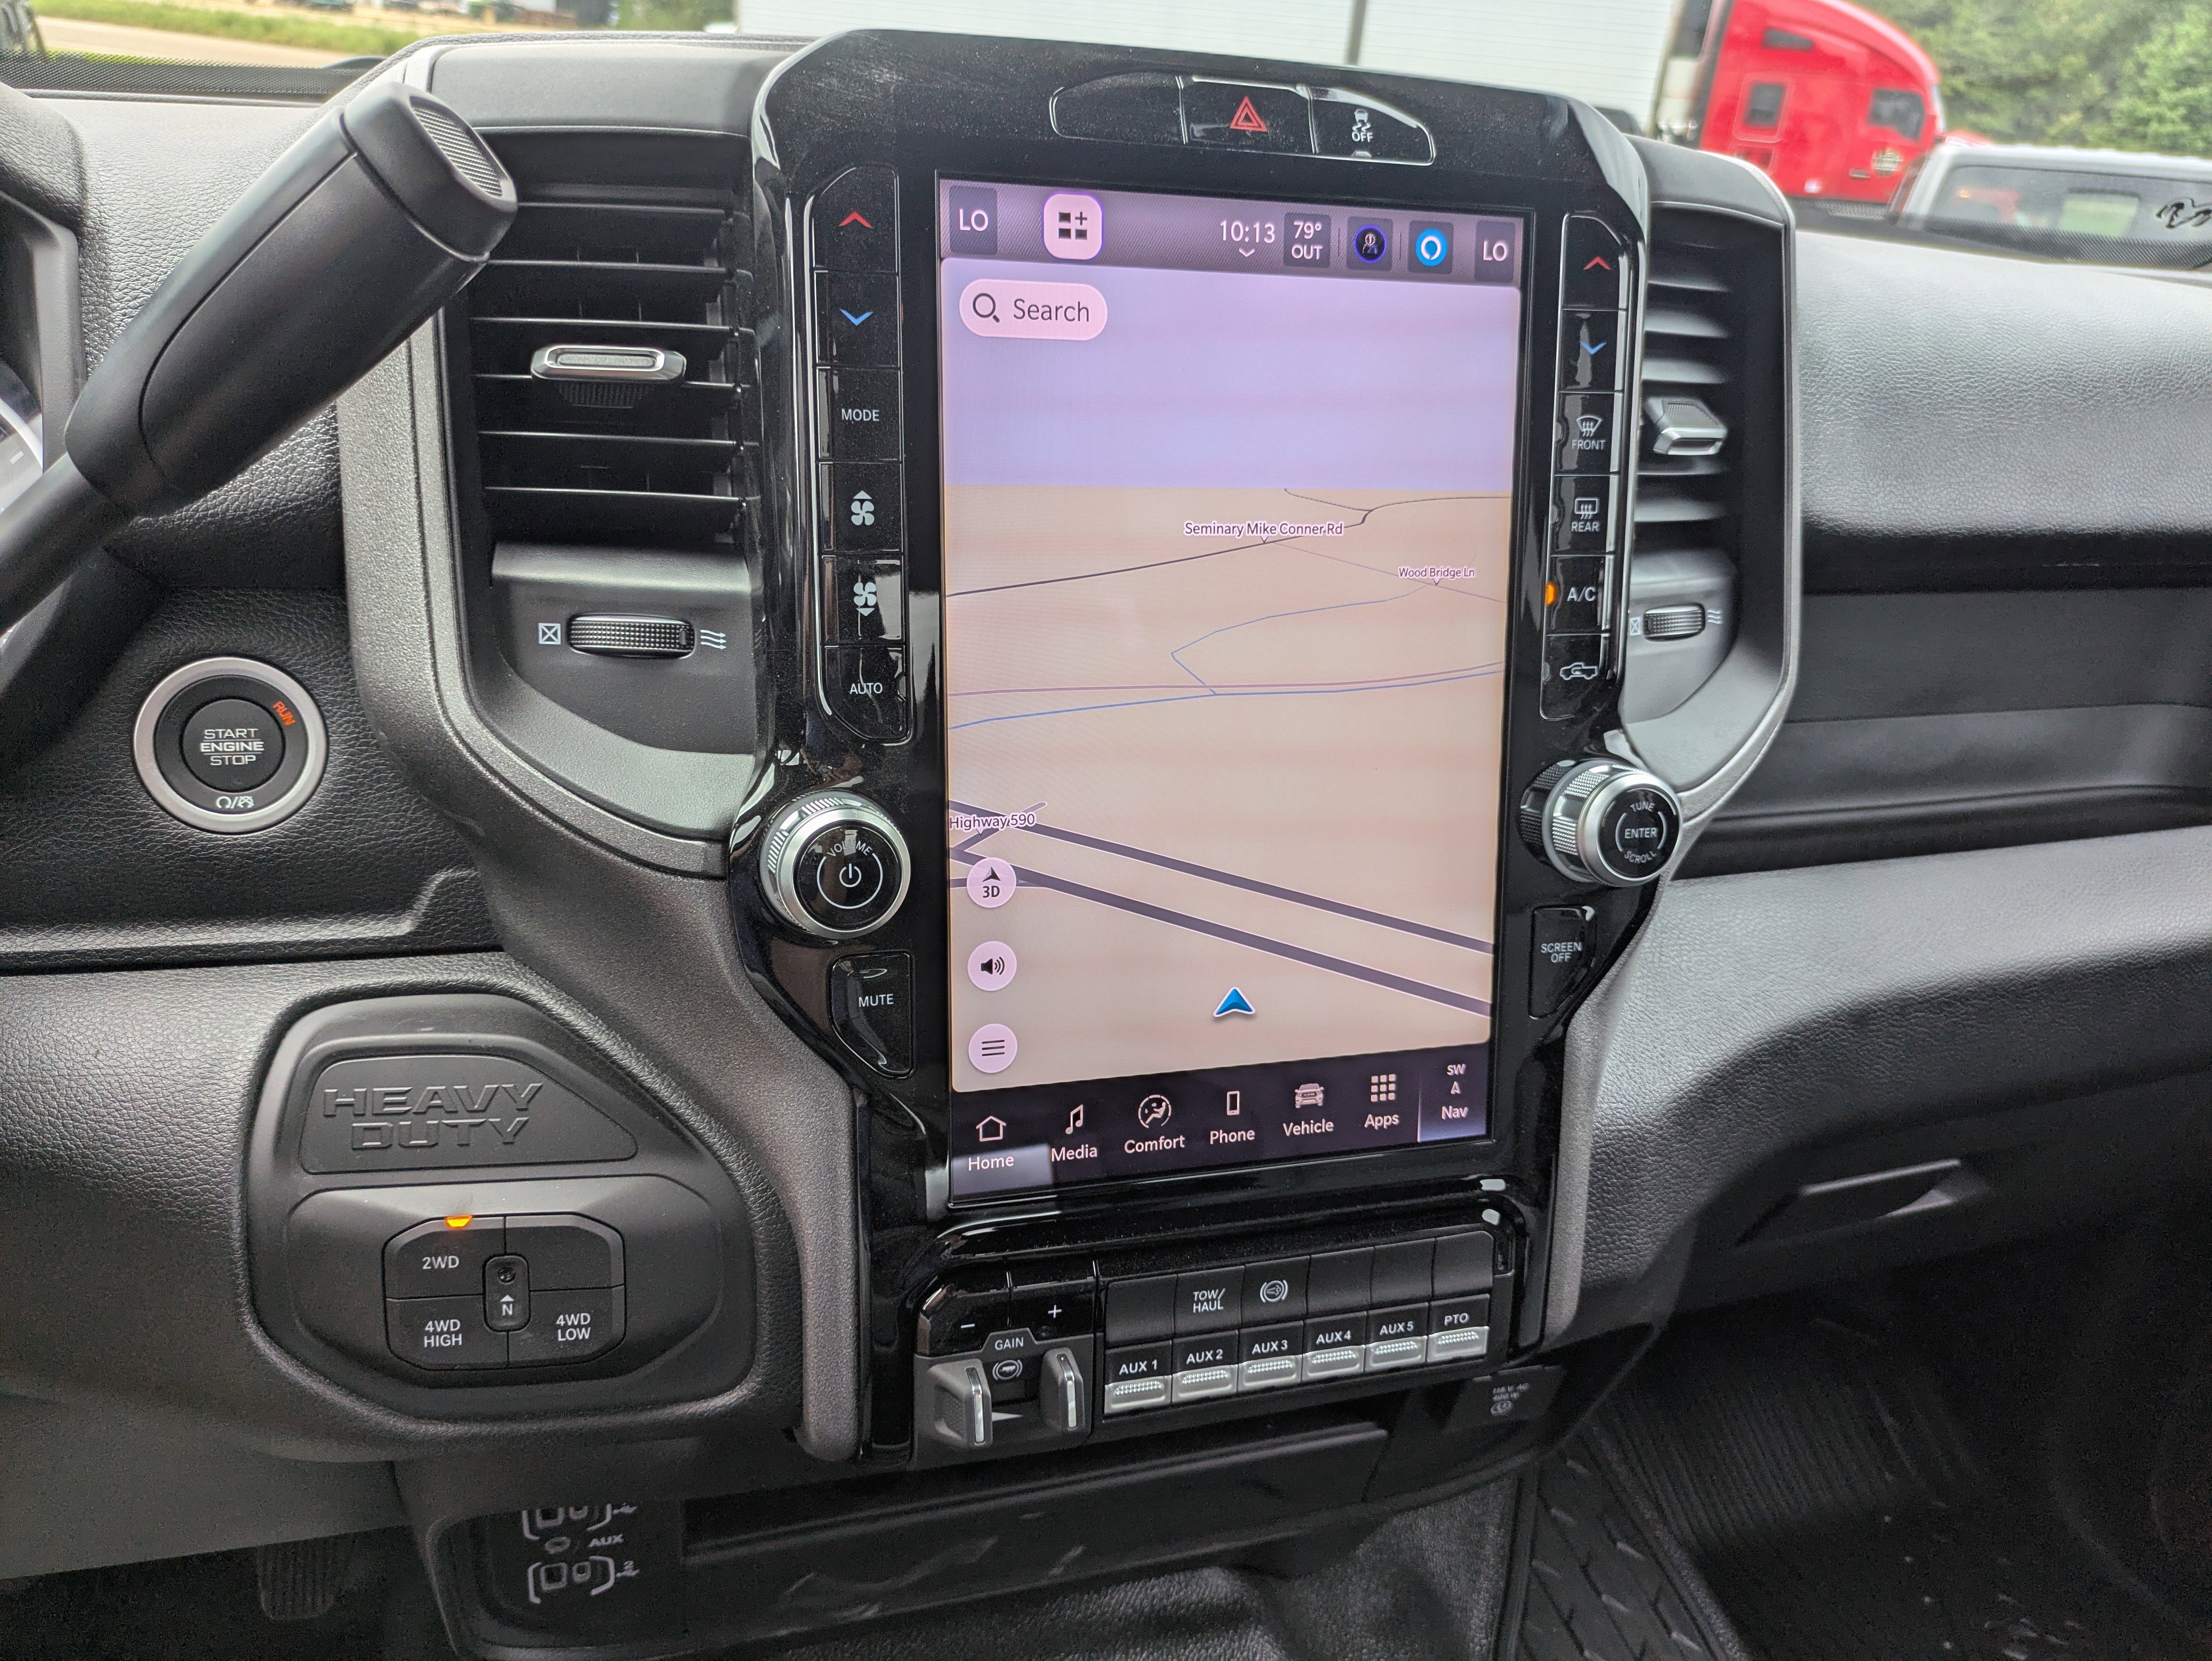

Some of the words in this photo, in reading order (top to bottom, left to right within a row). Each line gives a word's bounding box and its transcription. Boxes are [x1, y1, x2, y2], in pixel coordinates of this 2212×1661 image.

[1351, 131, 1373, 143] OFF
[958, 209, 989, 232] LO
[1220, 220, 1276, 244] 10:13
[1291, 244, 1323, 261] OUT
[1483, 241, 1508, 262] LO
[1013, 298, 1090, 322] Search
[841, 408, 880, 421] MODE
[1571, 440, 1606, 450] FRONT
[1184, 522, 1243, 537] Seminary
[1247, 522, 1277, 535] Mike
[1279, 523, 1325, 535] Conner
[1326, 522, 1343, 534] Rd
[1571, 522, 1600, 532] REAR
[1398, 567, 1427, 578] Wood
[1429, 567, 1461, 580] Bridge
[1463, 567, 1475, 577] Ln
[1567, 587, 1596, 602] A/C
[849, 683, 883, 695] AUTO
[272, 700, 296, 727] RUN
[203, 728, 259, 739] START
[200, 741, 265, 753] ENGINE
[210, 754, 256, 766] STOP
[1630, 801, 1656, 813] TUNE
[950, 815, 1009, 831] Highway
[1010, 813, 1035, 826] 590
[1625, 827, 1659, 840] ENTER
[826, 838, 873, 857] VOLUME
[1624, 850, 1658, 863] SCROLL
[982, 885, 1000, 898] 3D
[1540, 941, 1582, 953] SCREEN
[1550, 952, 1572, 963] OFF
[858, 994, 894, 1008] MUTE
[1447, 1063, 1466, 1075] SW
[323, 1083, 544, 1118] HEAVY
[1441, 1105, 1469, 1119] Nav
[1283, 1118, 1334, 1137] Vehicle
[1364, 1112, 1400, 1129] Apps
[351, 1117, 529, 1151] DUTY
[1210, 1129, 1255, 1145] Phone
[1124, 1134, 1186, 1154] Comfort
[1051, 1144, 1098, 1163] Media
[968, 1154, 1015, 1172] Home
[422, 1255, 459, 1270] 2WD
[1193, 1287, 1225, 1301] TOW/
[502, 1303, 513, 1316] N
[1193, 1299, 1225, 1313] HAUL
[425, 1319, 461, 1333] 4WD
[556, 1313, 591, 1327] 4WD
[1444, 1312, 1470, 1326] PTO
[557, 1327, 591, 1341] LOW
[1379, 1322, 1405, 1336] AUX
[1406, 1321, 1414, 1332] 5
[423, 1333, 463, 1348] HIGH
[995, 1336, 1024, 1351] GAIN
[1316, 1331, 1342, 1345] AUX
[1343, 1330, 1351, 1341] 4
[1251, 1341, 1279, 1355] AUX
[1280, 1340, 1288, 1351] 3
[1186, 1350, 1214, 1364] AUX
[1216, 1349, 1223, 1360] 2
[1119, 1361, 1149, 1375] AUX
[1152, 1359, 1158, 1370] 1
[587, 1533, 624, 1548] AUX
